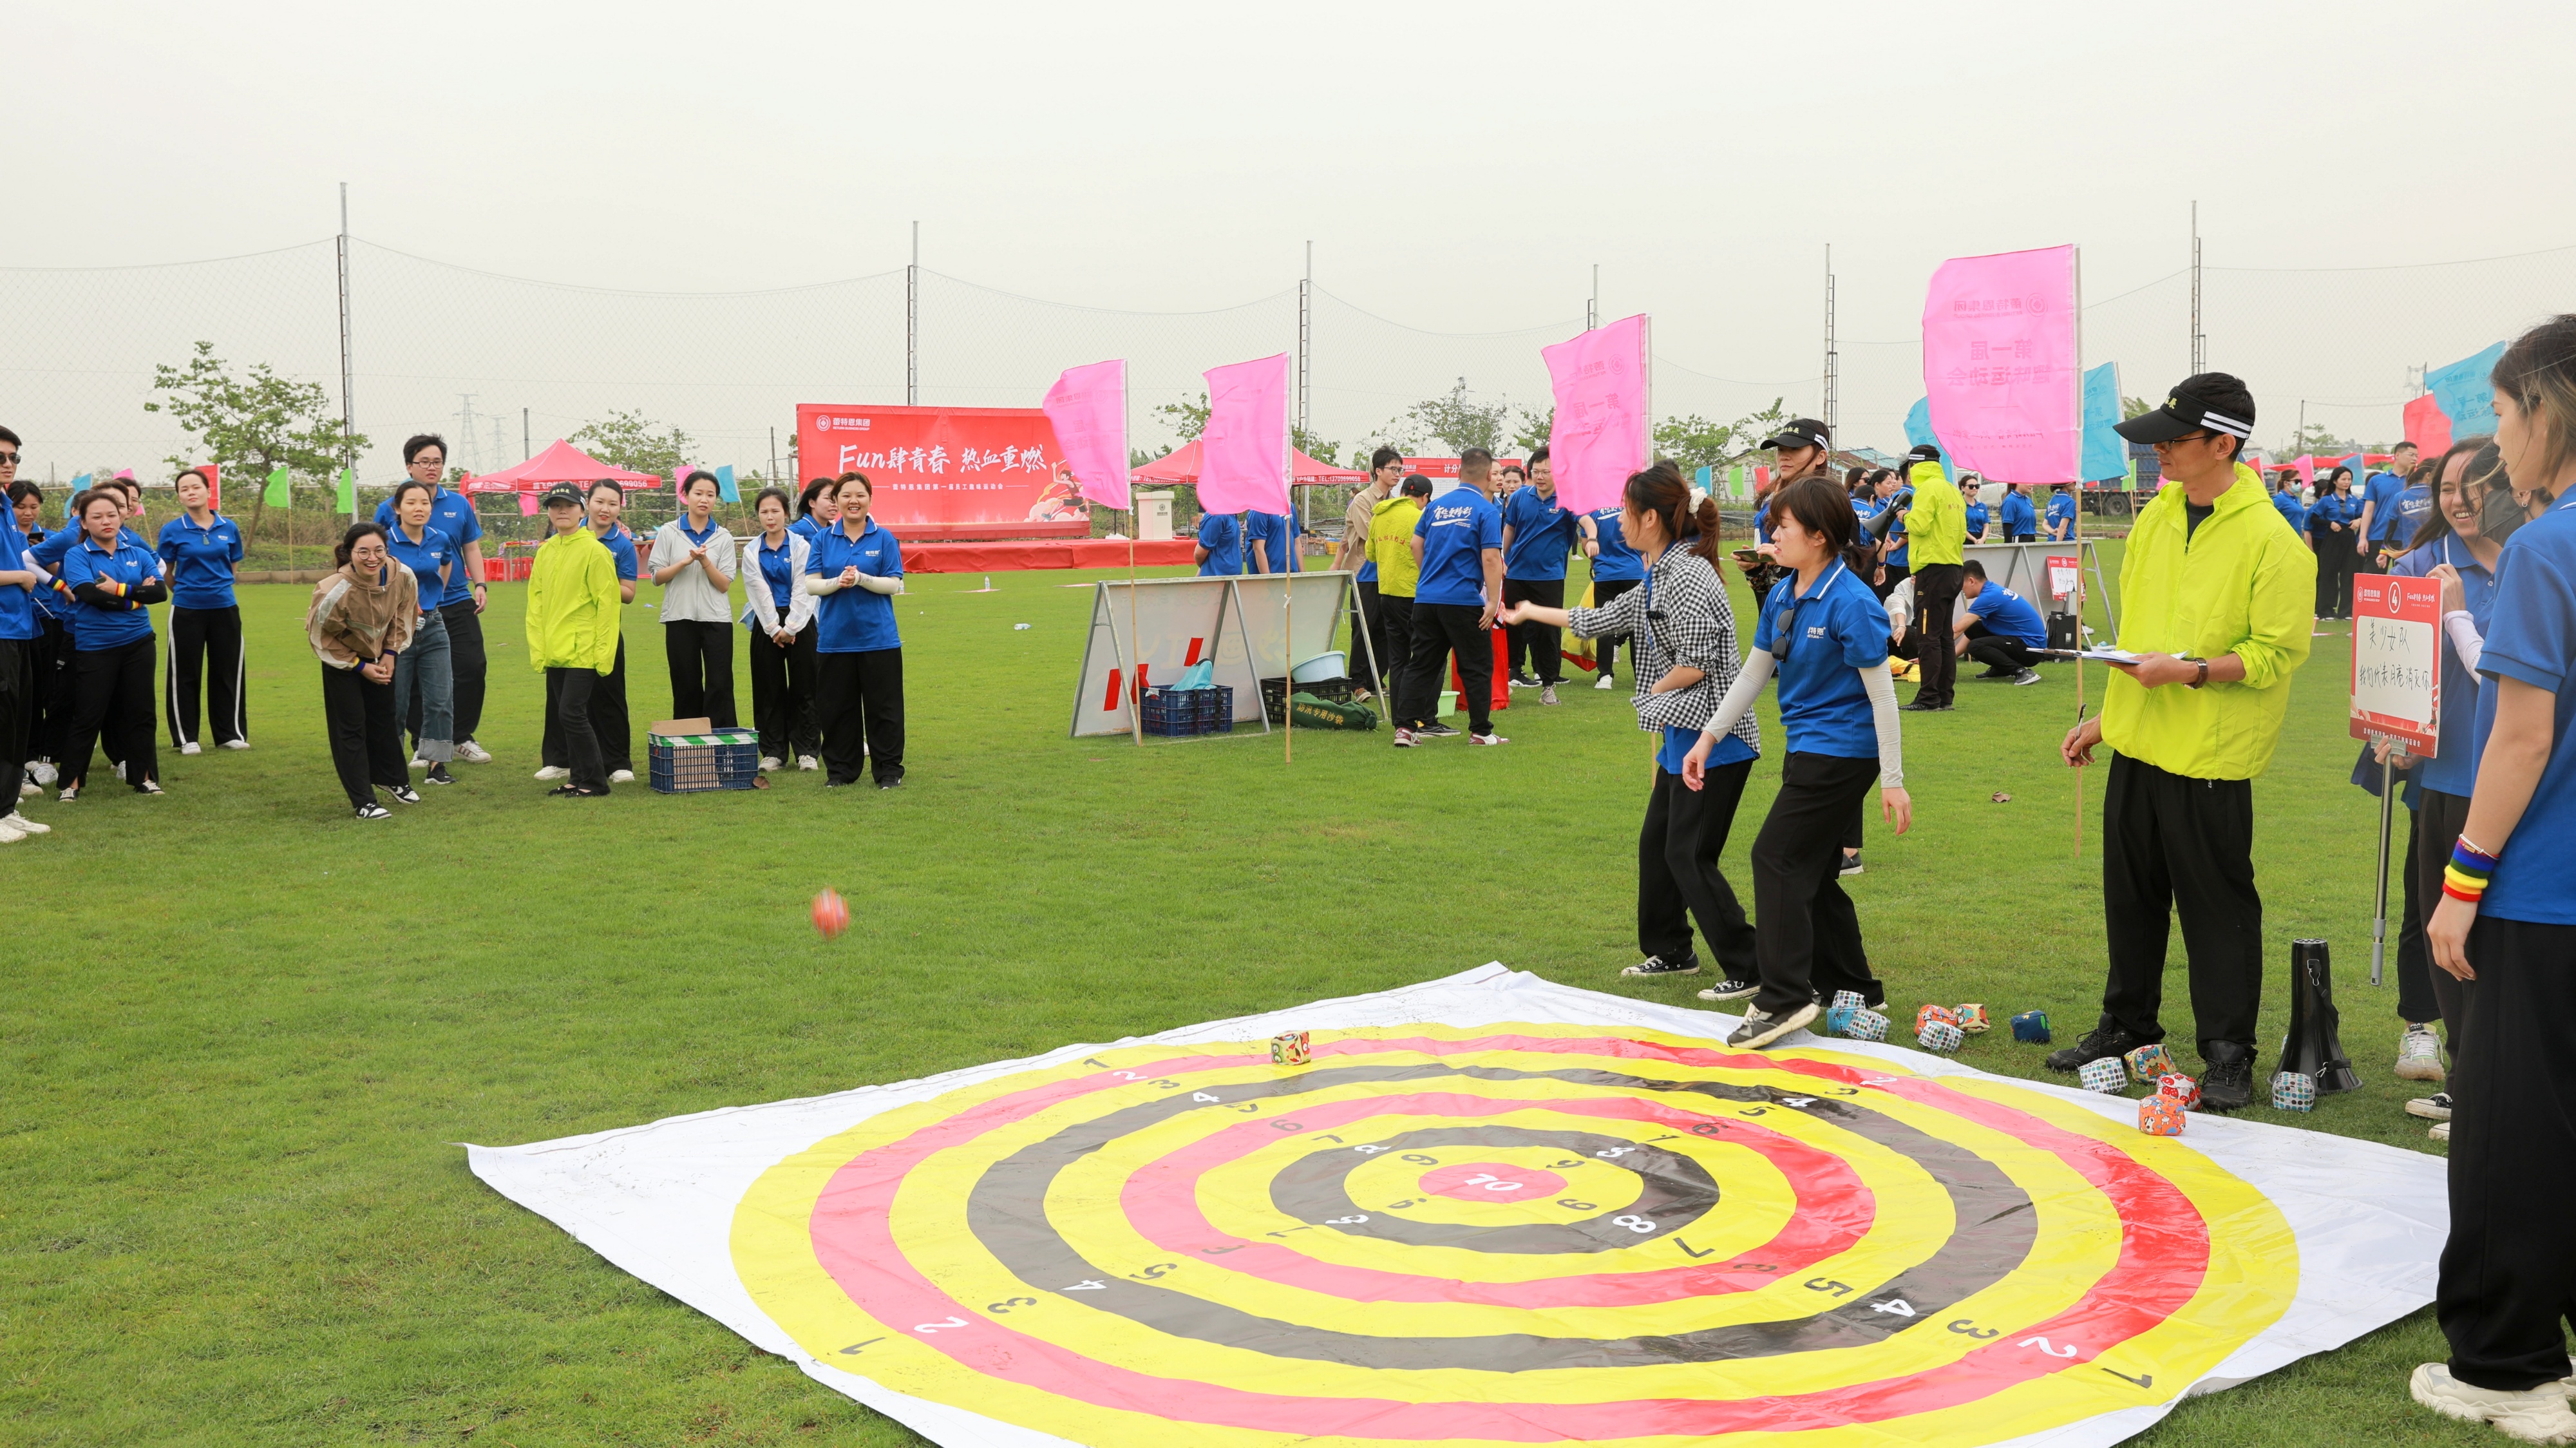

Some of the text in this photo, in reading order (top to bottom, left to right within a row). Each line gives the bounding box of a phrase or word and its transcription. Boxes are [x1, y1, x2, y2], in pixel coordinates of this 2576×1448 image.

[833, 417, 870, 426] 蕾特恩集团
[838, 444, 1047, 474] Fun肆青春 热血重燃
[2392, 589, 2397, 606] 4
[2370, 618, 2410, 654] 美少女队
[1296, 703, 1343, 725] 防汛专用沙袋
[1083, 1058, 1110, 1068] 1
[1113, 1071, 1148, 1080] 2
[1148, 1079, 1180, 1089] 3
[1193, 1092, 1220, 1103] 4
[1783, 1098, 1818, 1107] 4
[1464, 1173, 1523, 1191] 10
[1613, 1214, 1656, 1233] 8
[1673, 1237, 1716, 1258] 7
[1129, 1263, 1178, 1279] 5
[1061, 1279, 1107, 1290] 4
[1804, 1277, 1855, 1297] 5
[987, 1297, 1037, 1313] 3
[1870, 1299, 1916, 1317] 4
[913, 1316, 969, 1333] 2
[1947, 1319, 1999, 1339] 3
[2016, 1336, 2078, 1358] 2
[2100, 1367, 2152, 1389] 1
